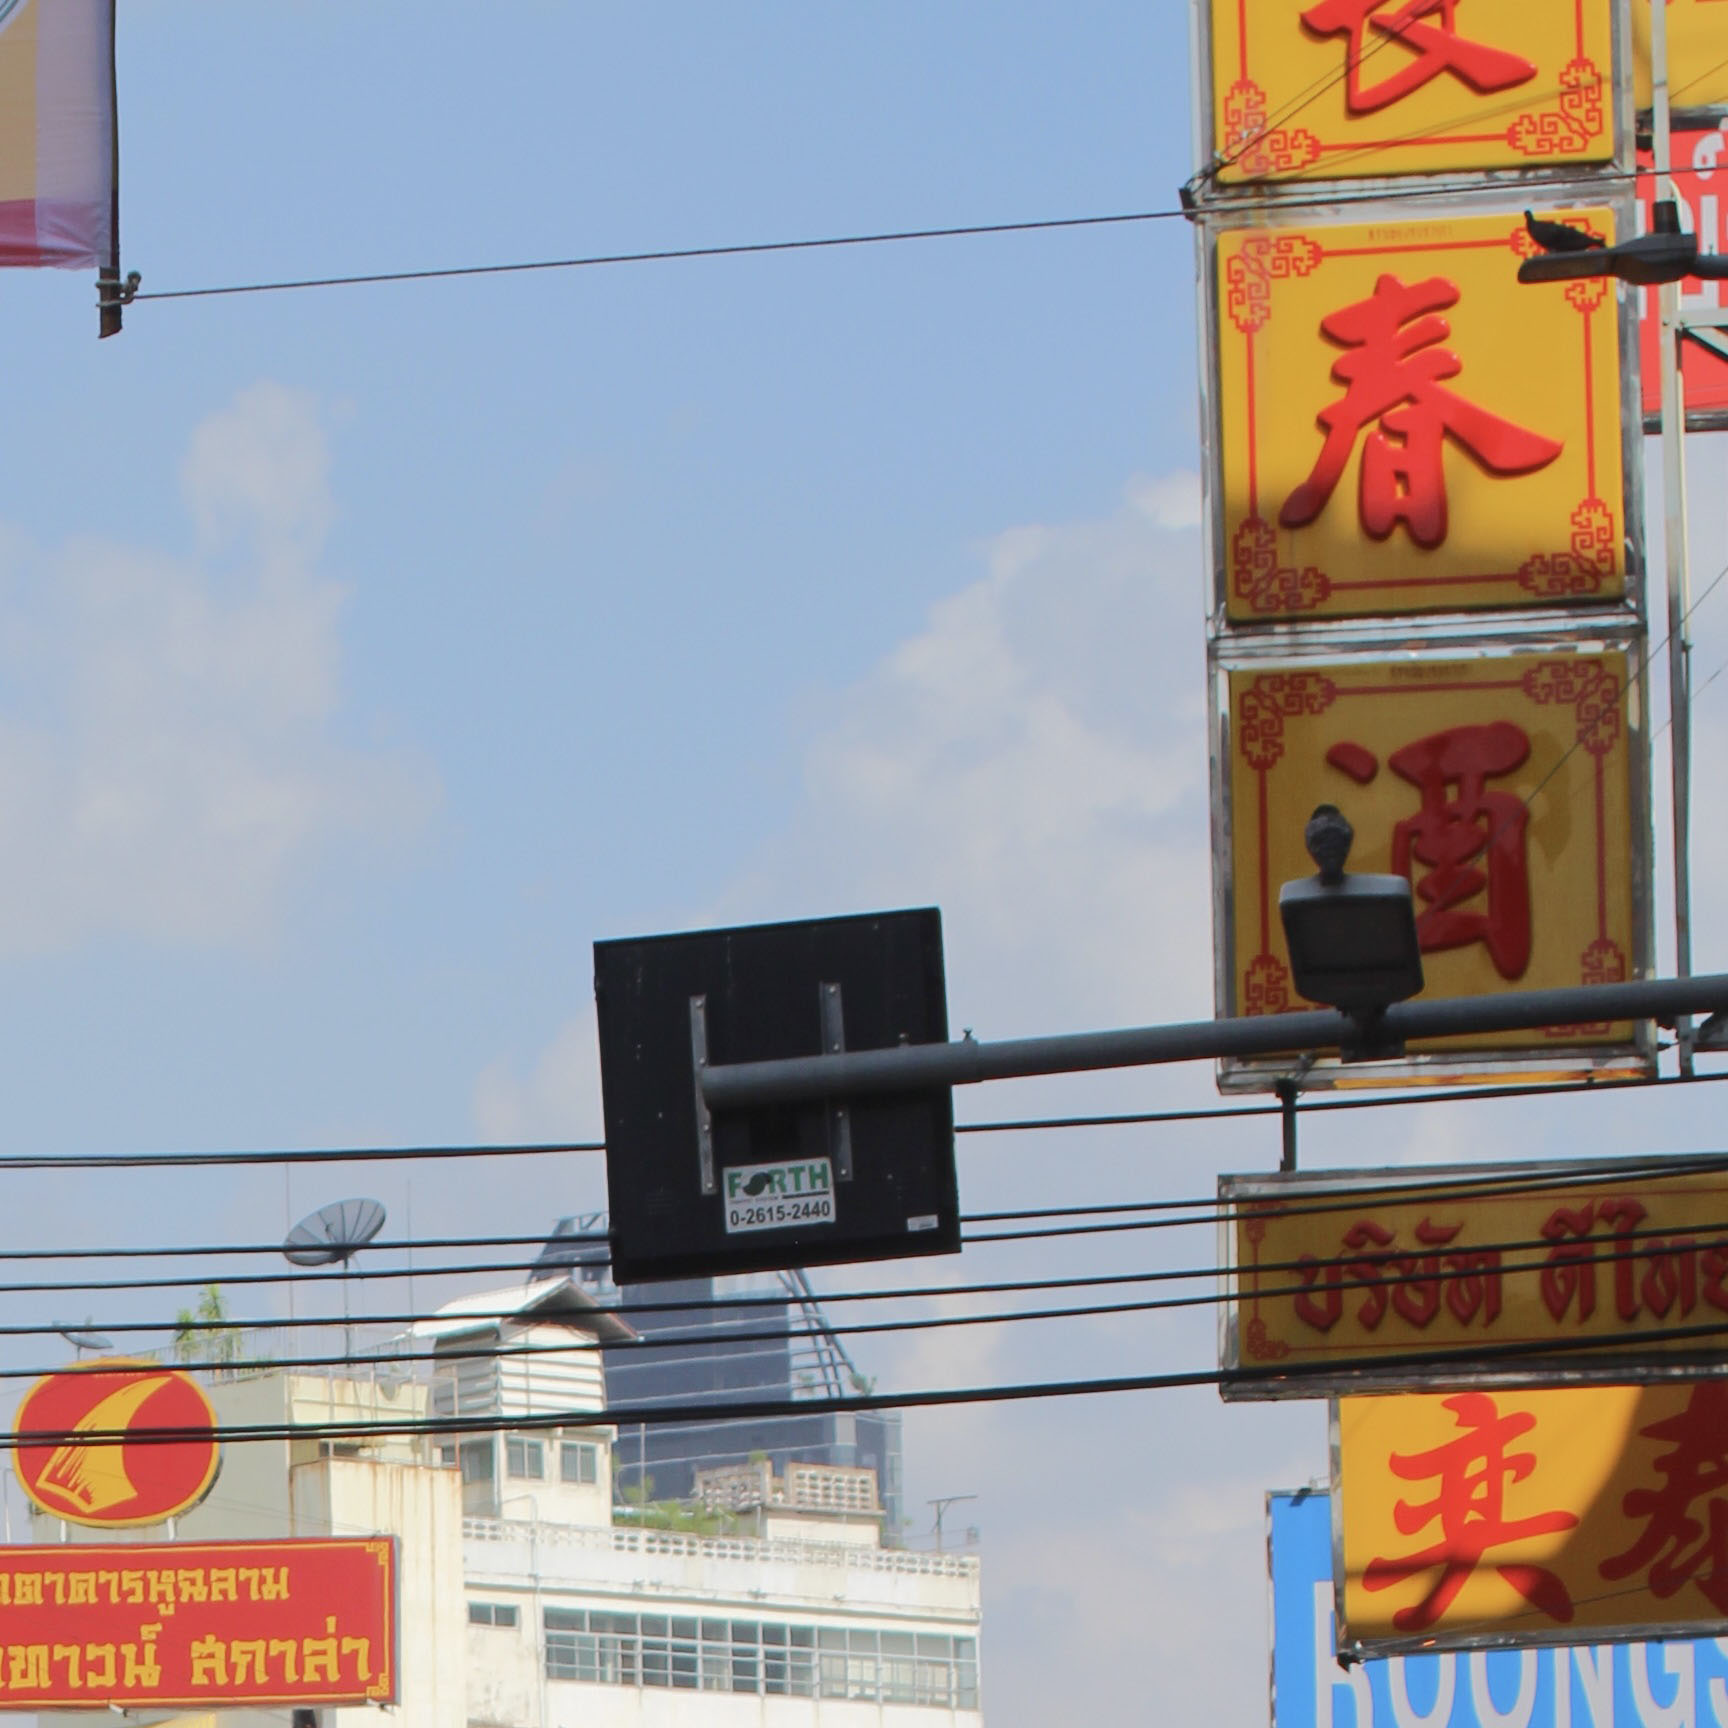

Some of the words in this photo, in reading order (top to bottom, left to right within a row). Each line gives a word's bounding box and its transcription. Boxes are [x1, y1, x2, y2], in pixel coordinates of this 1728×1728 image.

[1279, 273, 1565, 549] 春
[730, 1200, 830, 1226] 0-2615-2440
[190, 1614, 371, 1685] สกาล่า
